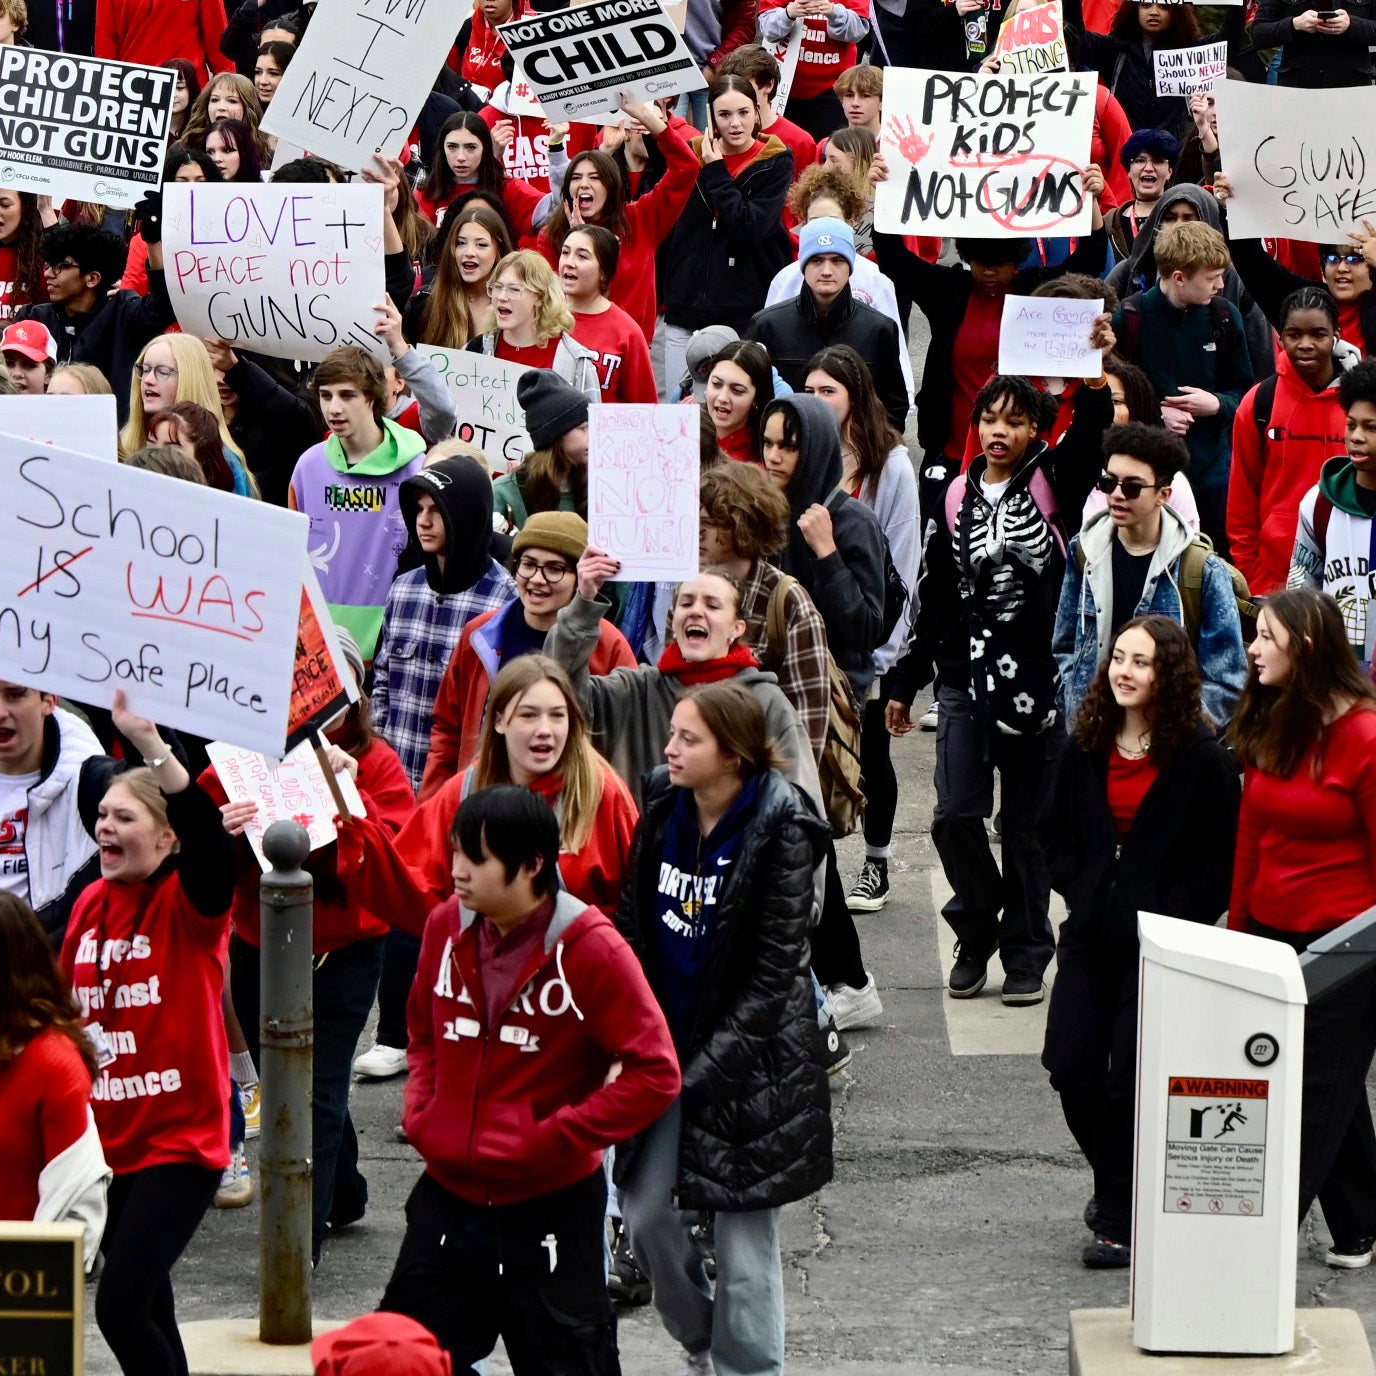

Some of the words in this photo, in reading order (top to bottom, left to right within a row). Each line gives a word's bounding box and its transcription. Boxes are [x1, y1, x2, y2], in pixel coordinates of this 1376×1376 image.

[334, 14, 404, 79] I
[503, 24, 544, 45] NOT
[549, 12, 594, 33] ONE
[1, 49, 171, 104] PROTECT
[523, 23, 677, 86] CHILD
[1003, 42, 1064, 73] STRONG
[293, 71, 408, 154] NEXT?
[8, 150, 25, 162] HOOK
[48, 157, 82, 170] COLUMBINE
[96, 165, 129, 178] PARKLAND
[133, 170, 157, 183] UVALDE
[64, 129, 159, 168] GUNS
[1255, 136, 1365, 188] G(UN)
[976, 171, 1084, 217] GUNS
[190, 189, 315, 245] LOVE
[175, 251, 266, 294] PEACE
[290, 255, 351, 285] not
[207, 290, 338, 345] GUNS
[429, 352, 510, 392] Protect
[15, 455, 220, 569] School
[325, 485, 386, 508] REASON
[127, 561, 265, 633] WAS
[1186, 1080, 1266, 1096] WARNING
[1168, 1144, 1197, 1152] Moving
[1238, 1146, 1263, 1154] Cause
[1200, 1155, 1223, 1163] Injury
